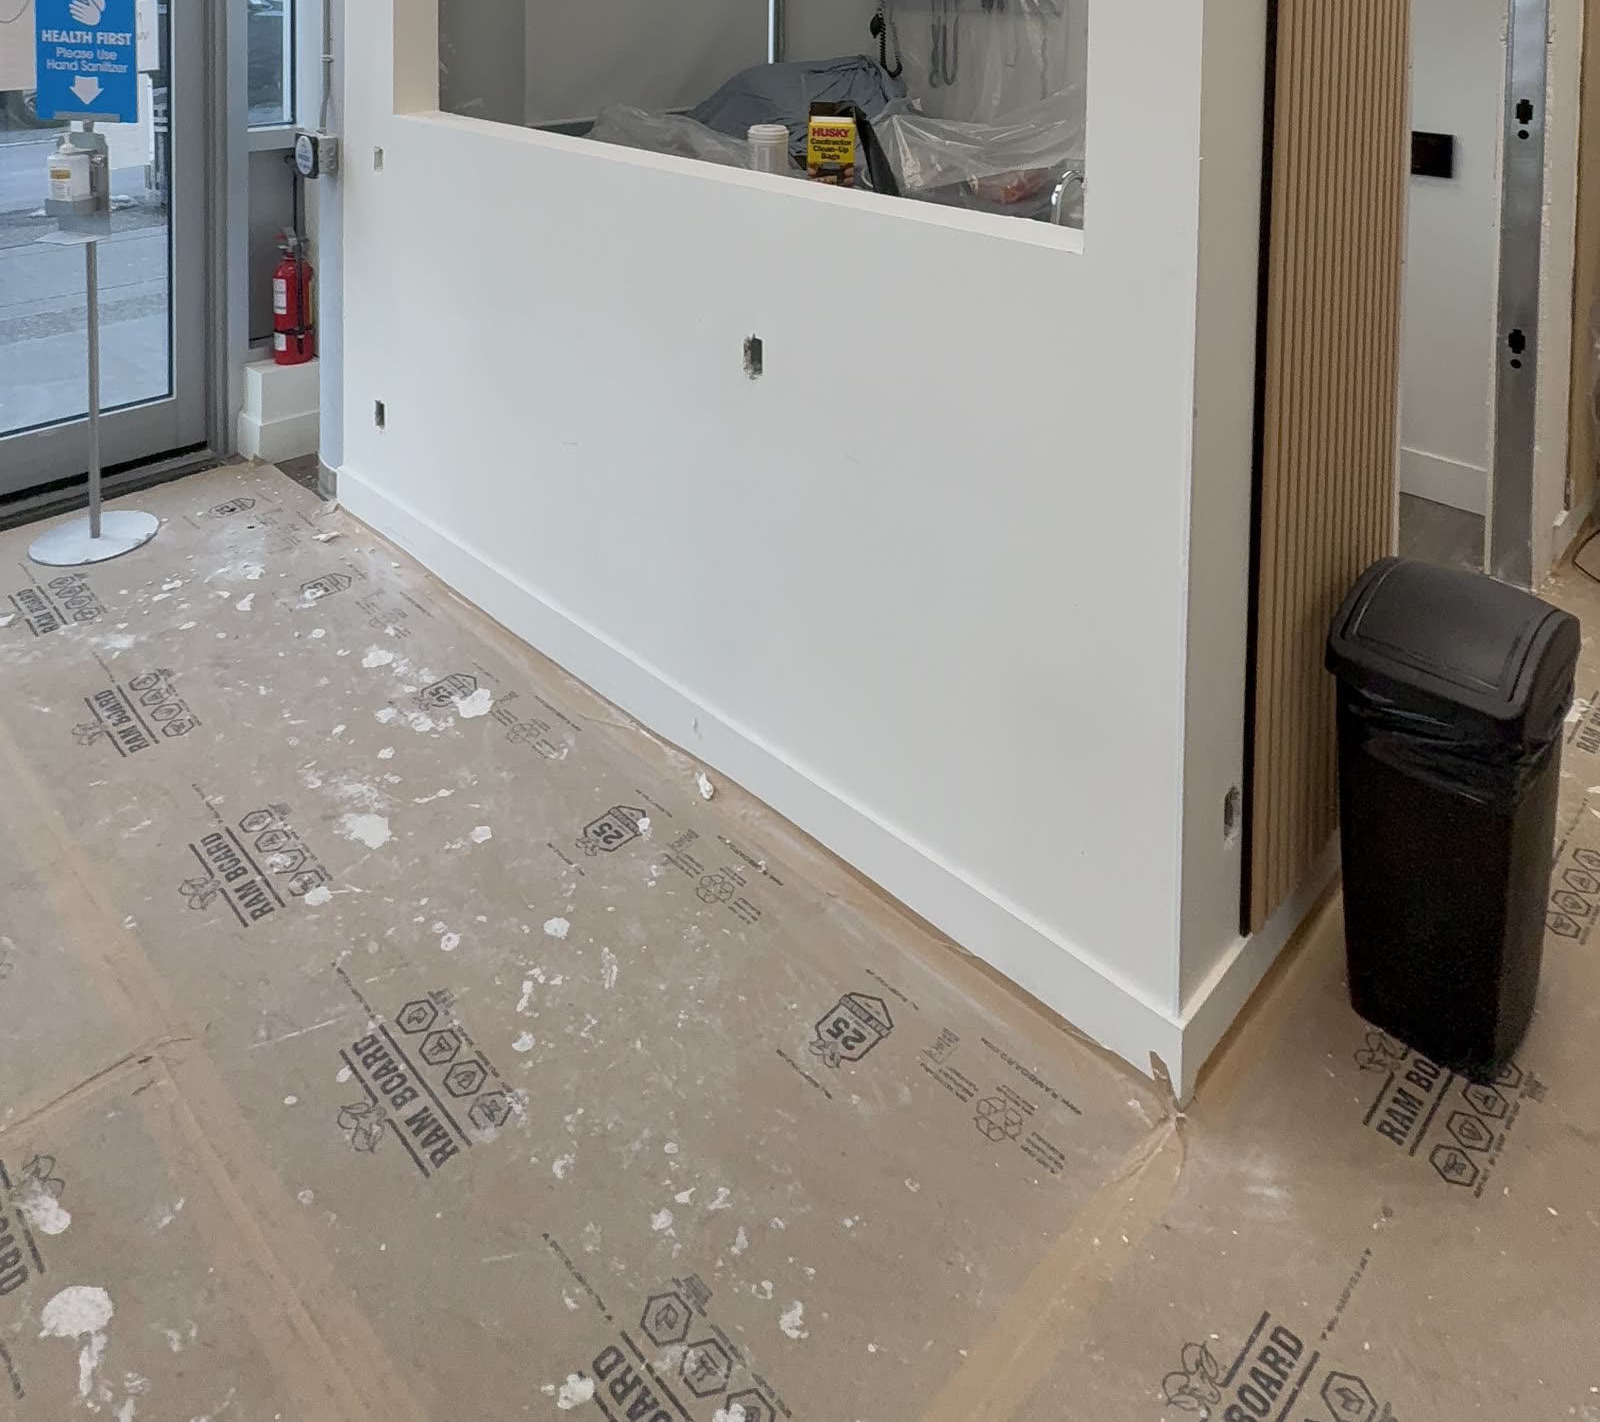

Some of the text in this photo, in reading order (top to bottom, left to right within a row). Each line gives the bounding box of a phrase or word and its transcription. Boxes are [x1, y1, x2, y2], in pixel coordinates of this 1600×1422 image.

[42, 30, 132, 46] HEALTH FIRST
[56, 47, 117, 60] Please Use
[47, 59, 128, 73] Hand Sanitizer
[812, 128, 849, 138] HUSKY
[428, 684, 452, 703] 25
[92, 688, 149, 753] RAM BOARD
[591, 819, 624, 846] 25
[198, 830, 249, 883] BOARD
[231, 878, 275, 921] RAM
[827, 1017, 866, 1050] 25
[350, 1031, 419, 1110] BOARD
[1375, 1087, 1424, 1146] RAM
[402, 1104, 460, 1168] RAM
